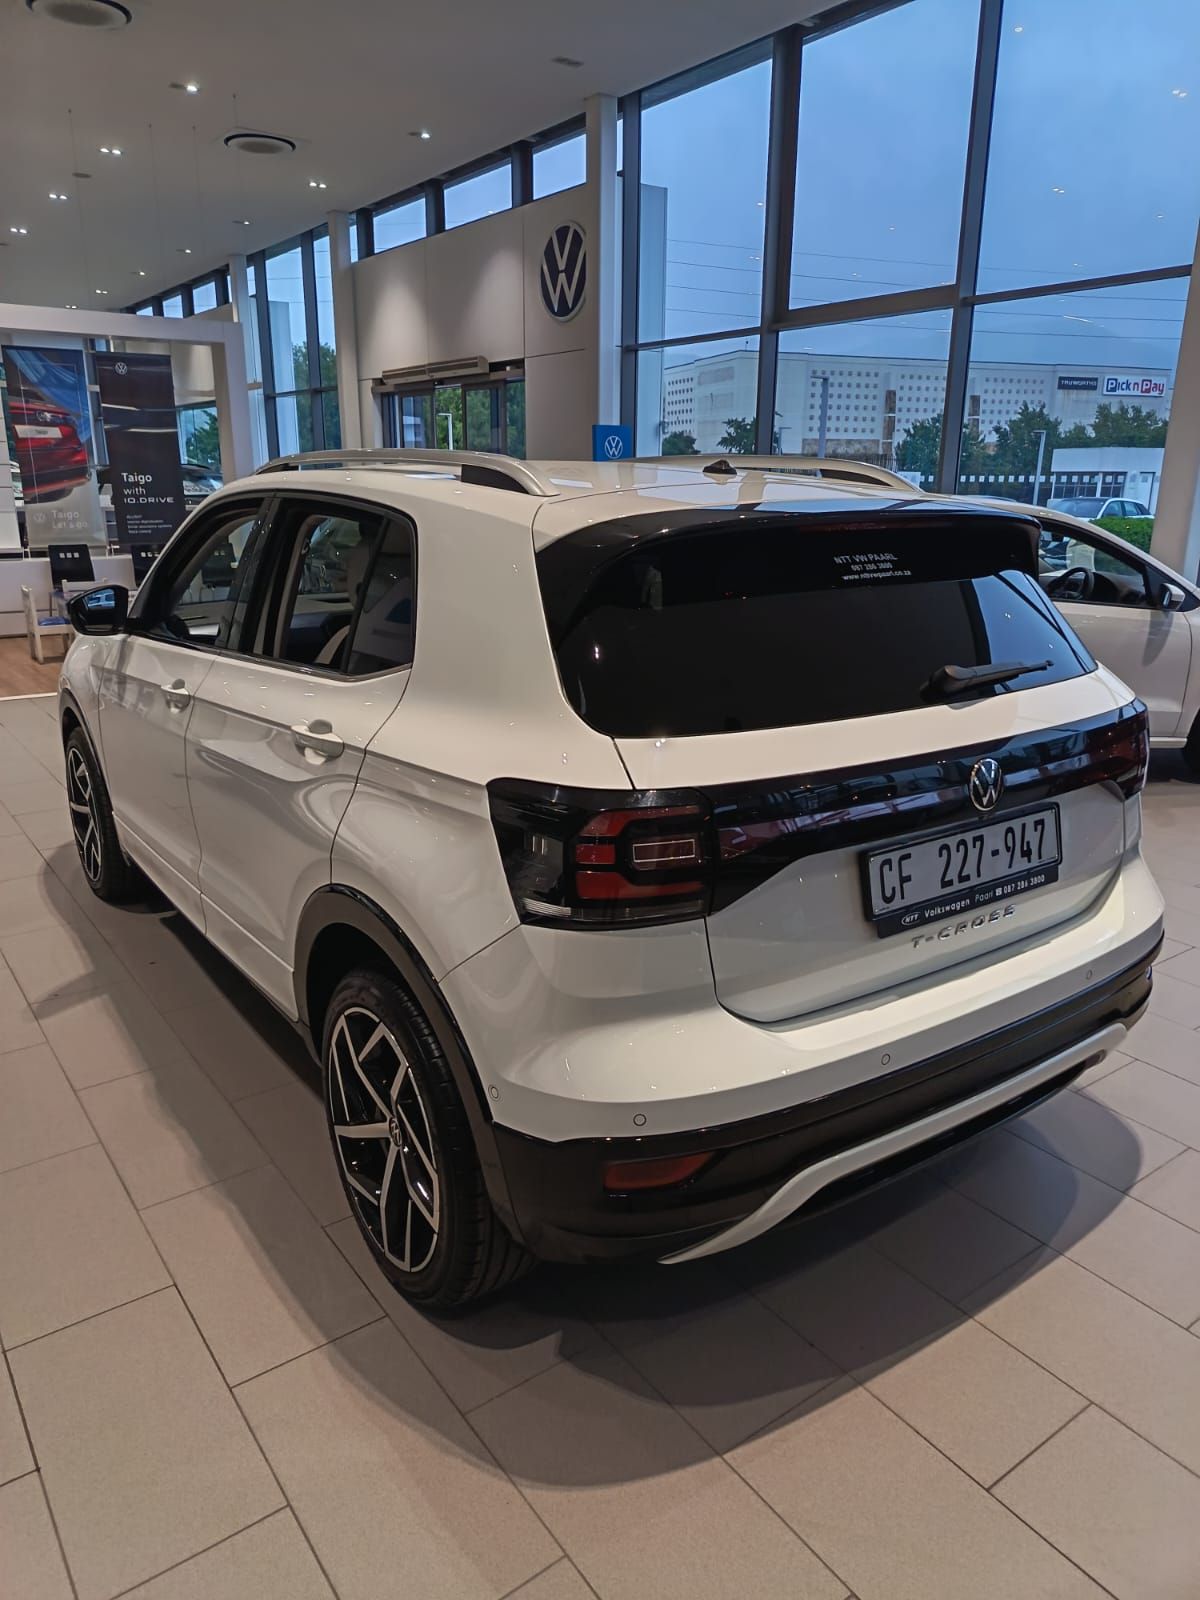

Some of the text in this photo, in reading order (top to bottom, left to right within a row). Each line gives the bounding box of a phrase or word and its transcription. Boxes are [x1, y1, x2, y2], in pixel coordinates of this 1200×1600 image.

[121, 472, 152, 484] Taigo
[123, 486, 146, 495] with
[868, 553, 899, 561] PAARL
[879, 818, 1045, 905] CF 227-947
[924, 898, 970, 918] Volkswagen
[975, 891, 994, 903] Paarl
[911, 903, 1017, 948] T-CROSS
